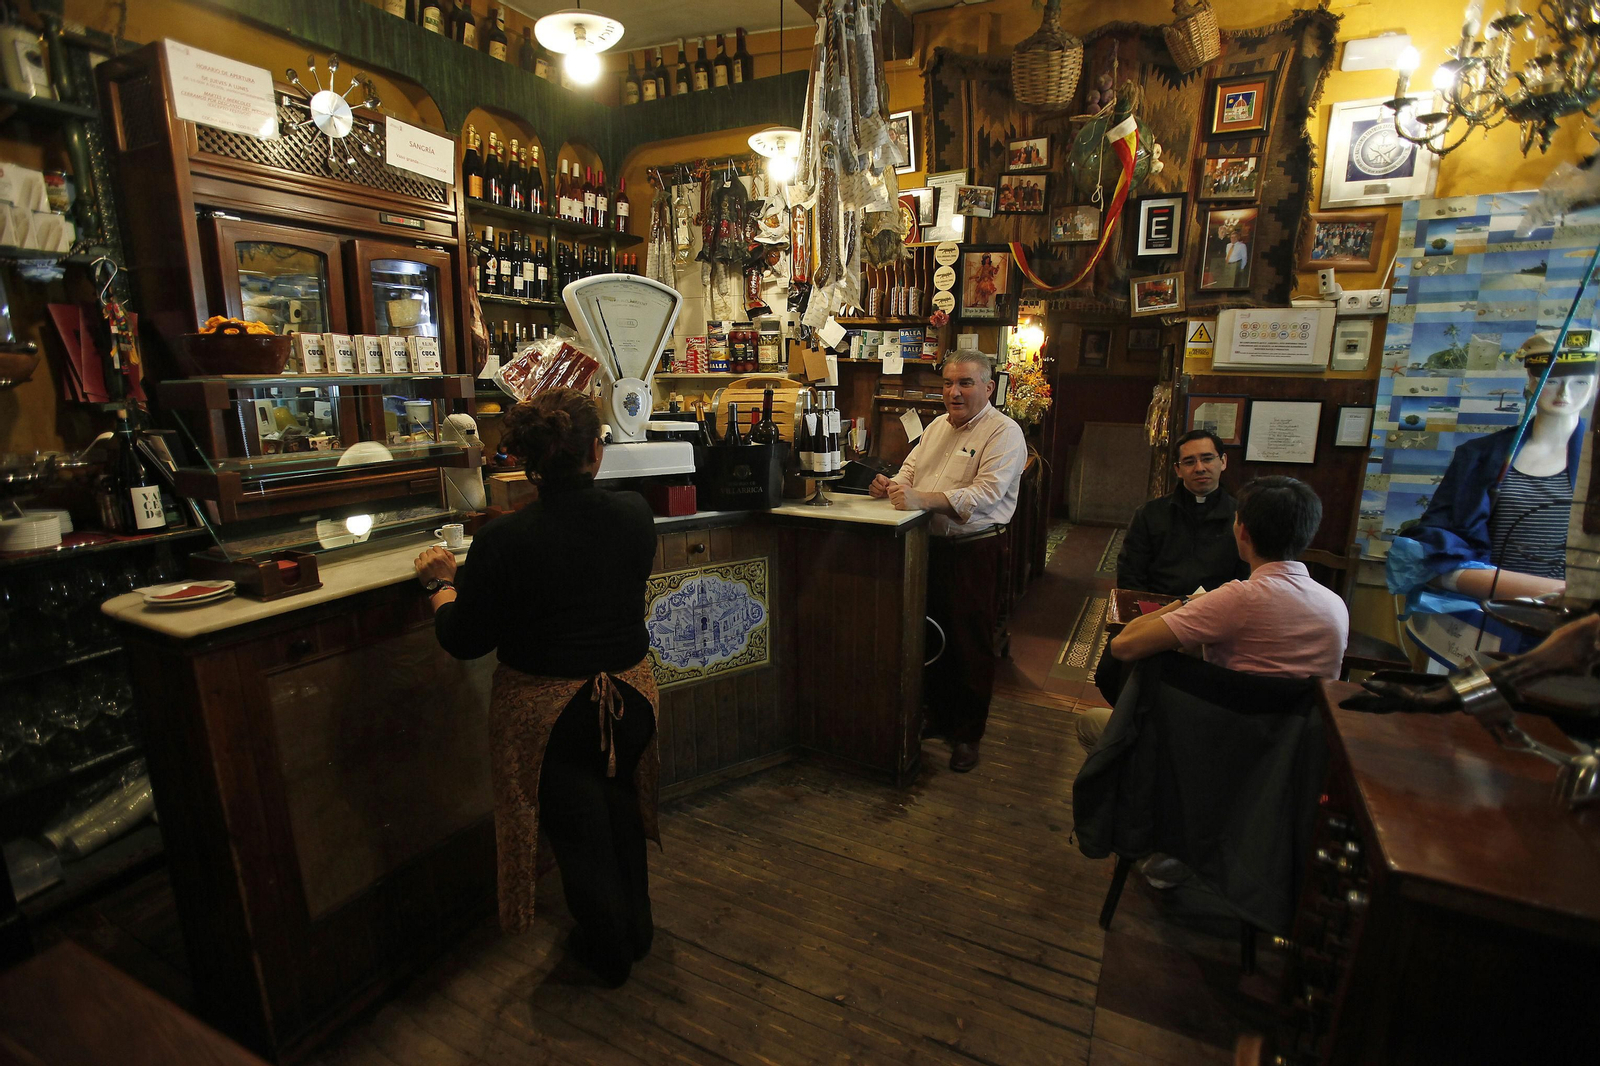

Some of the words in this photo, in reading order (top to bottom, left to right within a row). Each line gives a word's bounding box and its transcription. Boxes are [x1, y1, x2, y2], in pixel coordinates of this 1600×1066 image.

[196, 63, 221, 75] HORARIO
[230, 72, 256, 84] APERTURA
[210, 77, 228, 87] JUEVES
[234, 83, 249, 92] LUNES
[181, 90, 207, 101] CERRAMOS
[217, 100, 242, 111] DESCANSO
[203, 91, 222, 100] MARTES
[409, 140, 435, 155] SANGRÍA
[1152, 216, 1169, 239] E
[339, 349, 353, 357] CUCA
